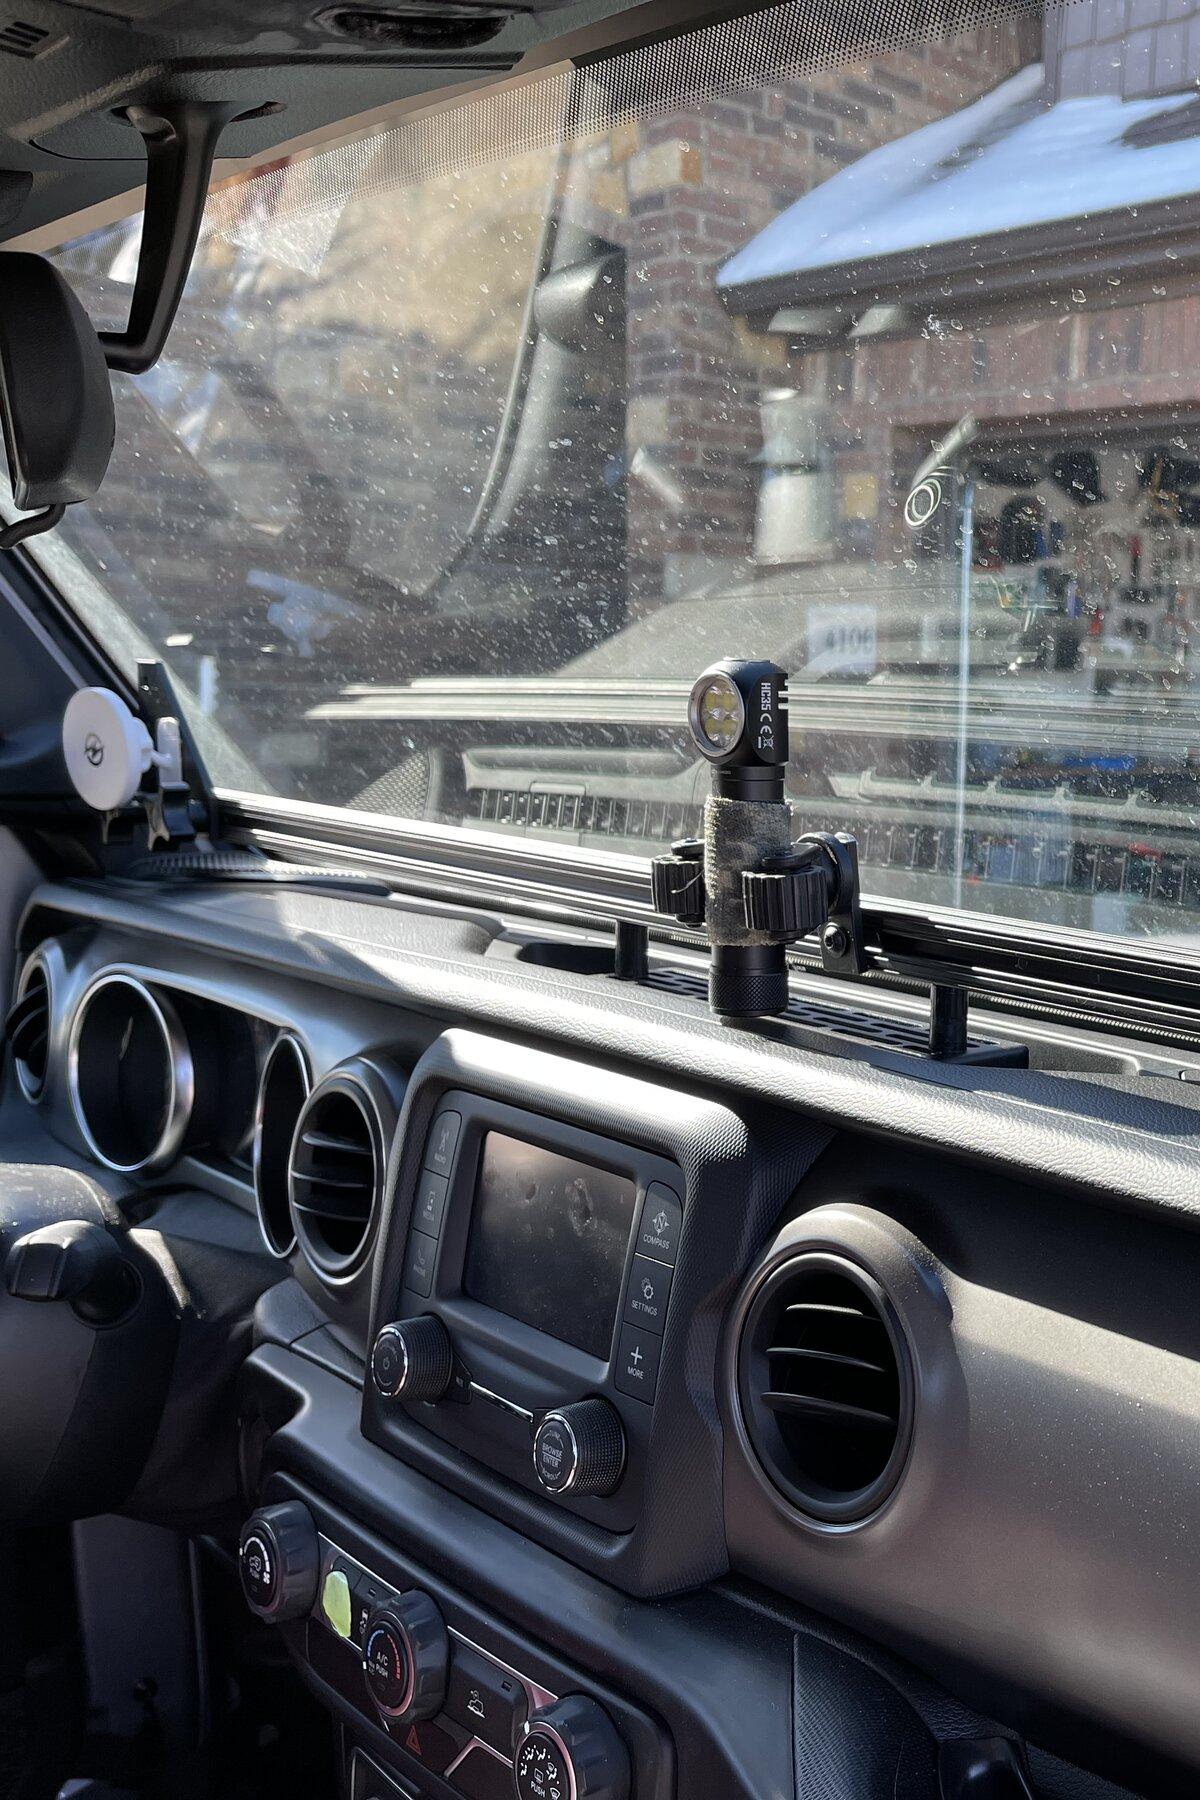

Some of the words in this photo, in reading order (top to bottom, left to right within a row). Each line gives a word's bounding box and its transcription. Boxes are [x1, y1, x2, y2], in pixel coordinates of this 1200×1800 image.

[761, 682, 772, 711] HC35
[760, 713, 772, 734] CE
[643, 1234, 670, 1250] COMPASS
[631, 1299, 658, 1316] SETTINGS
[627, 1366, 644, 1380] MORE
[541, 1442, 563, 1459] BROWSE
[542, 1455, 559, 1468] ENTER
[376, 1651, 389, 1666] A/C
[375, 1663, 389, 1679] PUSH
[530, 1780, 546, 1798] PUSH
